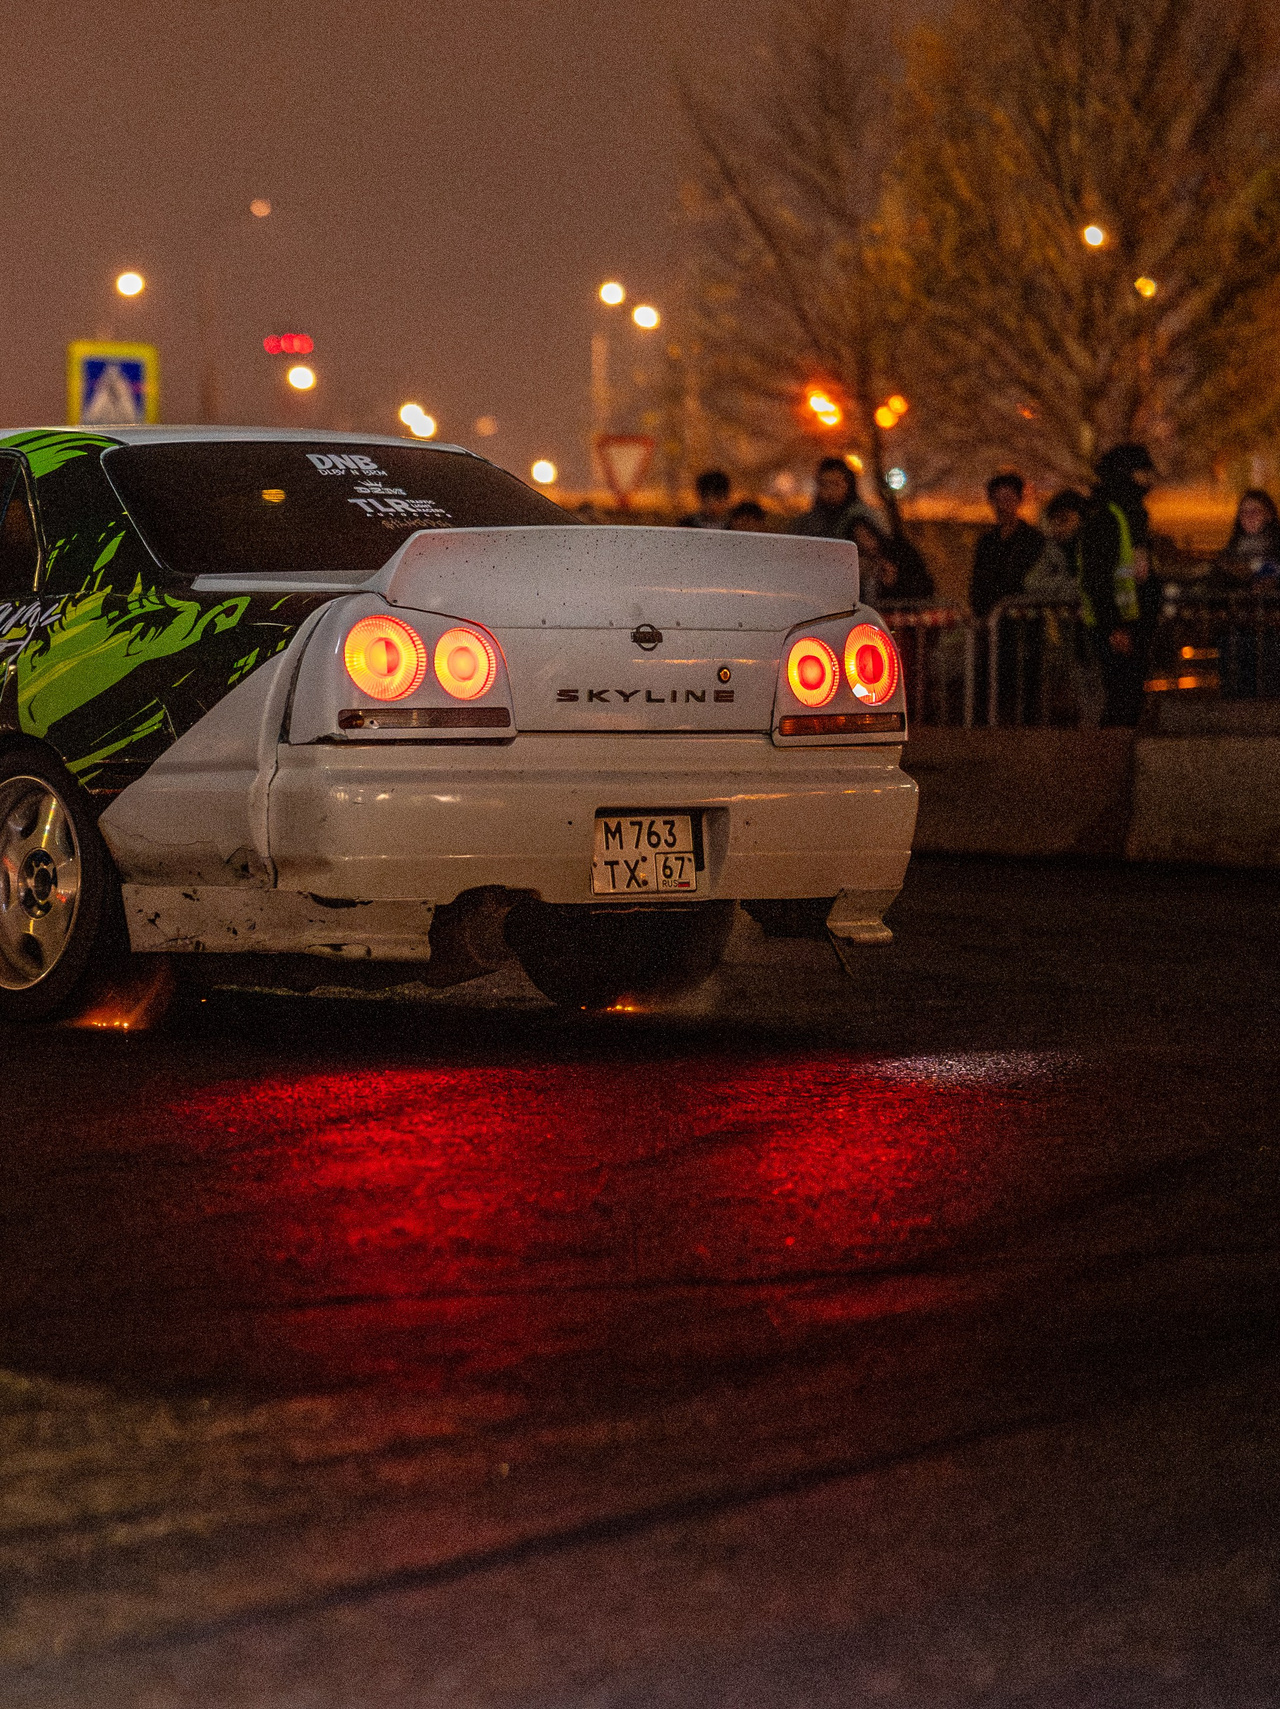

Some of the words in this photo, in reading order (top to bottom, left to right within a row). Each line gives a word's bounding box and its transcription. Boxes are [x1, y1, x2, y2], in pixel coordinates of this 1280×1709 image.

[305, 453, 378, 470] DNB
[347, 498, 418, 513] TLR
[556, 688, 735, 703] SKYLINE
[603, 859, 642, 889] TX
[662, 856, 685, 879] 67
[662, 880, 678, 888] RUS
